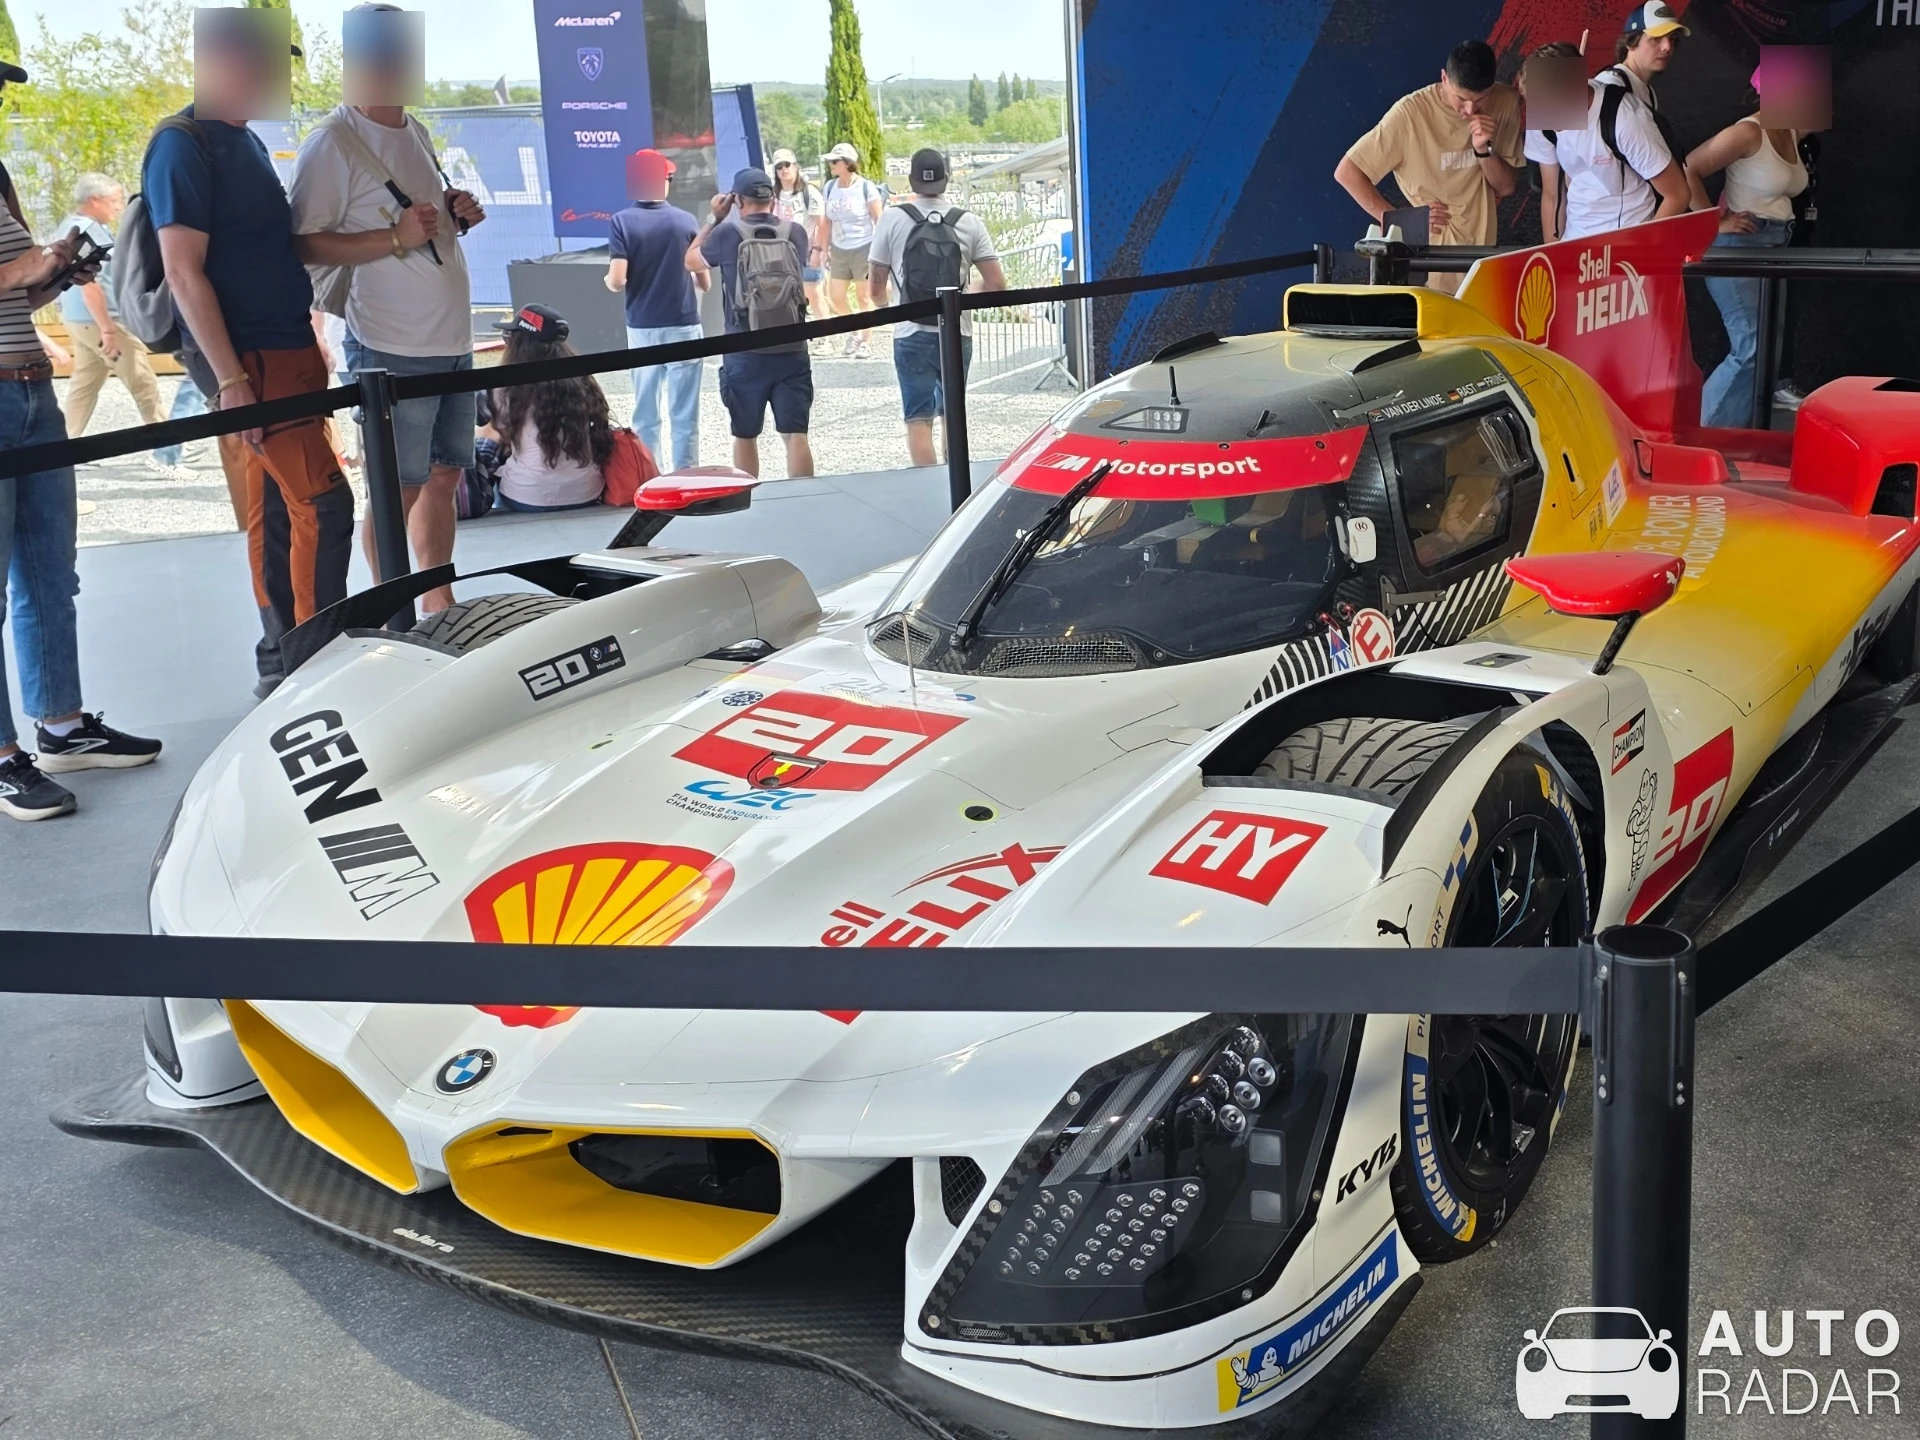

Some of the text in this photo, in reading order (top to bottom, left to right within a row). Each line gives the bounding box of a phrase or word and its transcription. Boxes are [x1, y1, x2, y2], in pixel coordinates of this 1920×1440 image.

[554, 16, 616, 27] McLaren
[561, 101, 628, 110] PORSCHE
[574, 130, 621, 142] TOYOTA
[1440, 149, 1479, 171] PUM
[1578, 244, 1612, 284] Shell
[1576, 261, 1649, 336] HELIX
[1382, 393, 1446, 419] VAN DER LINDE
[1456, 383, 1478, 398] RAST
[1093, 457, 1261, 479] Motorsport
[1641, 494, 1692, 538] POWER
[1691, 495, 1727, 539] COMMAND
[523, 653, 591, 696] 20
[714, 706, 930, 766] 20
[1613, 724, 1645, 760] CHAMPION
[269, 709, 384, 824] GEN
[666, 798, 739, 822] CHAMPIONSHIP
[672, 792, 782, 821] FIA WORLD ENDURANCE
[1168, 819, 1313, 881] HY
[820, 900, 887, 948] ell
[1431, 906, 1445, 948] ORT
[1412, 1073, 1457, 1220] MICHELIN
[1335, 1132, 1398, 1206] KYB
[392, 1227, 455, 1253] dallara
[1286, 1256, 1388, 1365] MICHELIN
